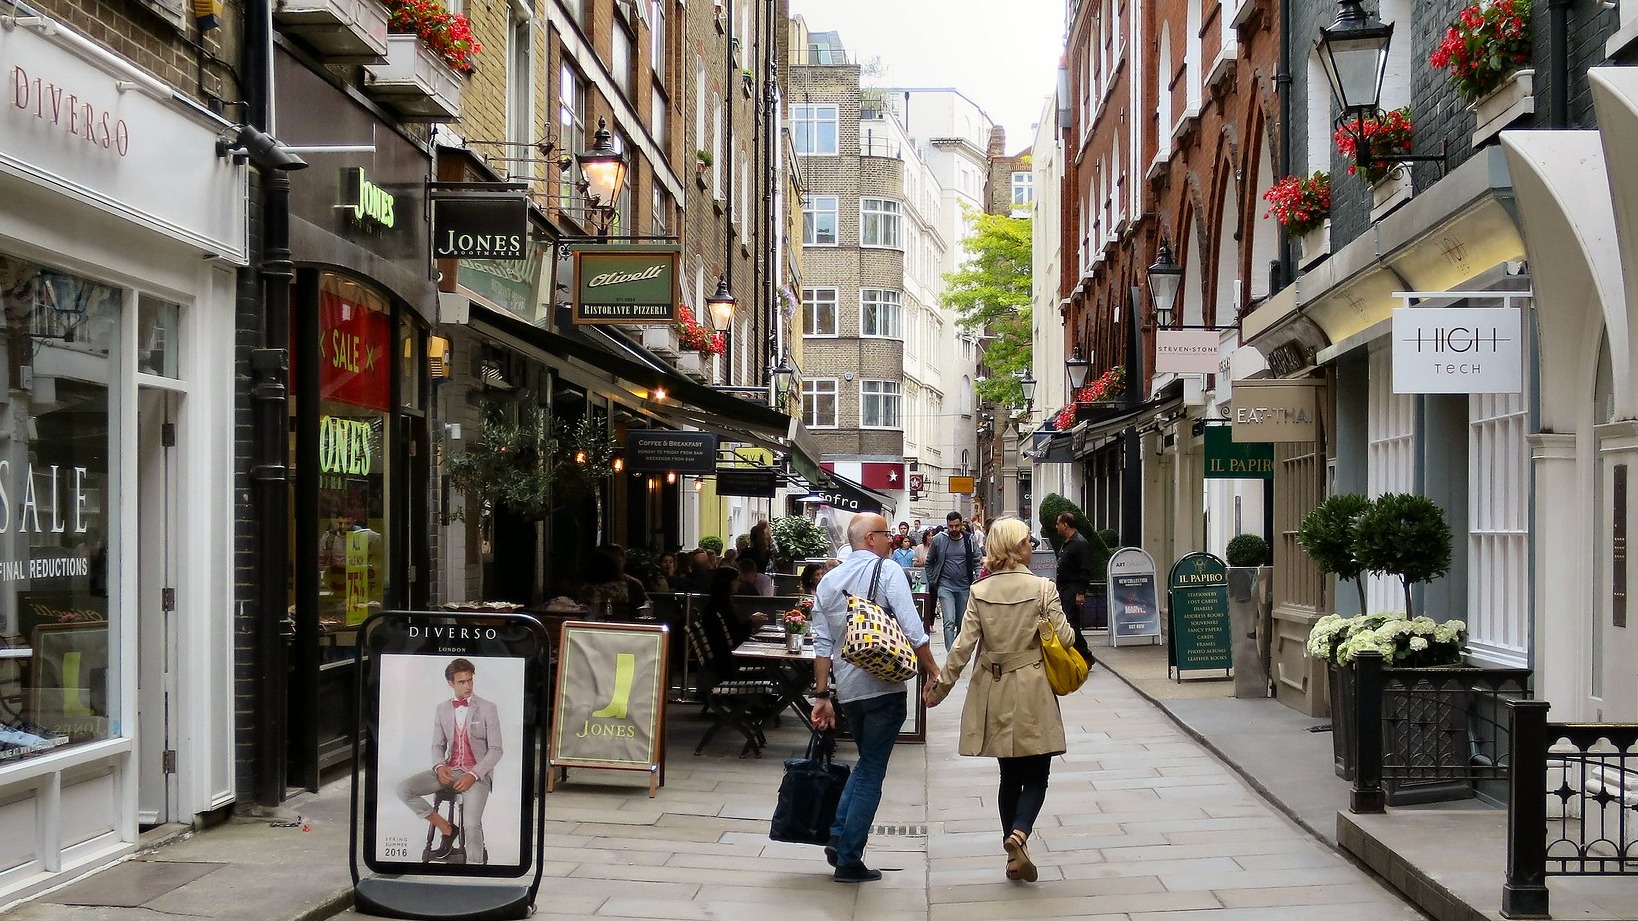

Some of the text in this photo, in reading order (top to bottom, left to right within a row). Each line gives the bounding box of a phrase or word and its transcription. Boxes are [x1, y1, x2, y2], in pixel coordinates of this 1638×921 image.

[15, 65, 129, 156] DIVERSO
[354, 166, 394, 228] JONES
[438, 230, 520, 254] JONES
[588, 264, 666, 288] Olivelli
[584, 304, 667, 315] RISTORANTE PIZZERIA
[1417, 327, 1497, 352] HIGH
[332, 328, 360, 374] SALE
[1237, 408, 1312, 424] EAT-THA
[320, 415, 371, 476] ONES
[1210, 458, 1274, 472] IL PAPIR
[0, 460, 88, 534] SALE
[818, 492, 859, 509] sofra
[30, 558, 88, 578] REDUCTIONS
[1191, 574, 1222, 582] PAPIRO
[409, 626, 496, 640] DIVERSO
[576, 720, 634, 738] JONES
[385, 848, 407, 857] 2016
